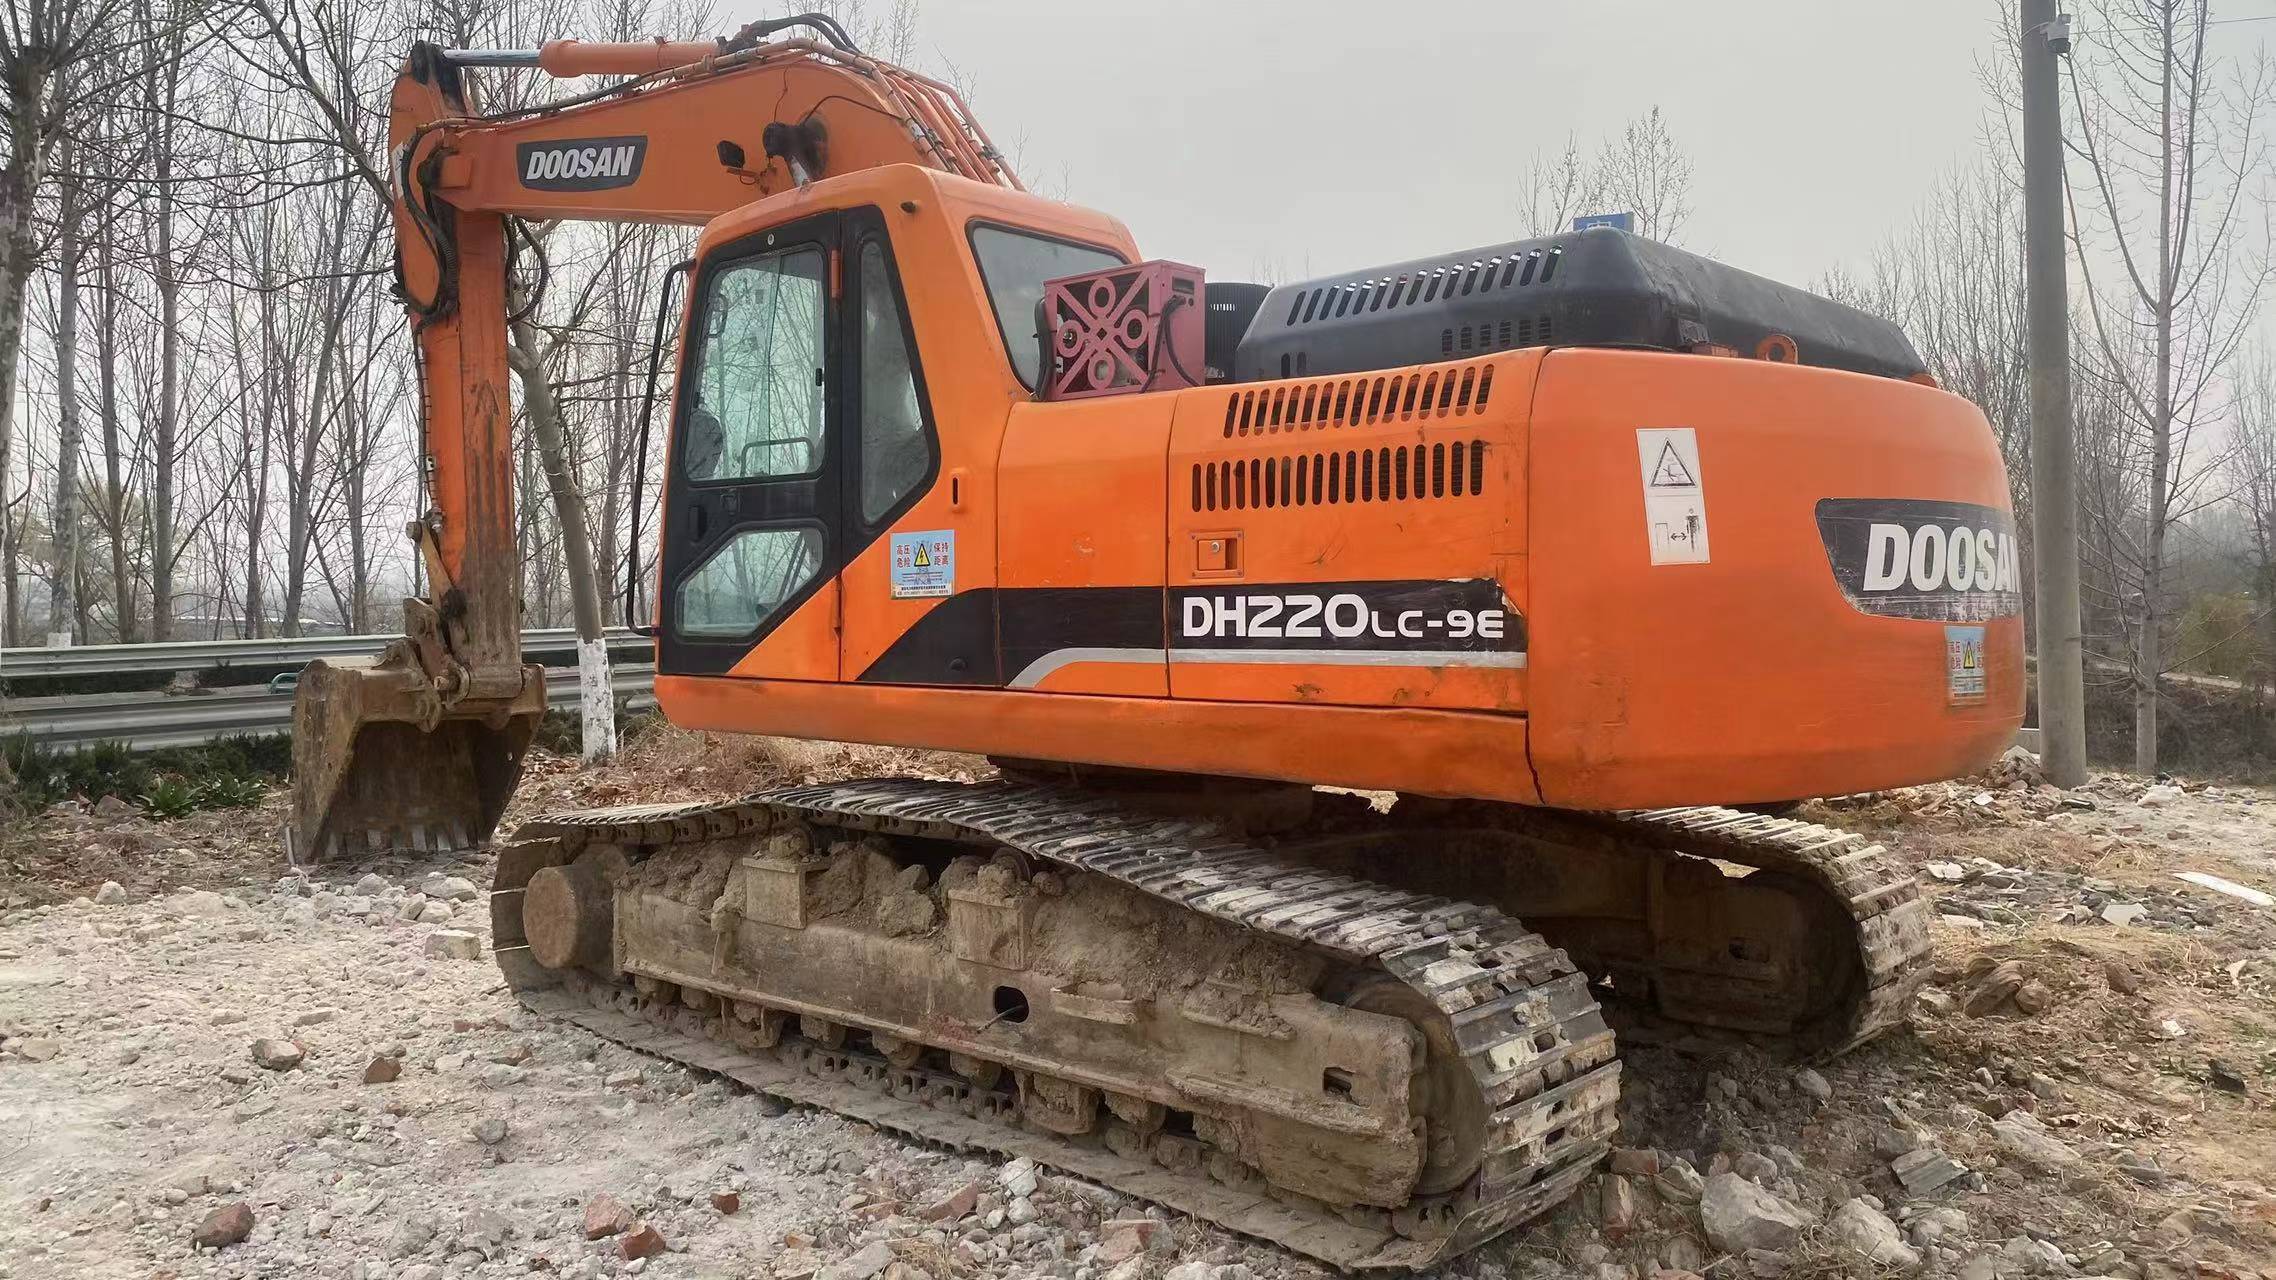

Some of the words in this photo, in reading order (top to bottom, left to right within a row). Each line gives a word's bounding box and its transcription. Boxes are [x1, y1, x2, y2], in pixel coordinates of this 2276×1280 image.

[526, 145, 636, 180] DOOSAN
[896, 544, 911, 556] 高压
[933, 542, 949, 553] 保持
[896, 557, 911, 568] 危险
[1182, 593, 1504, 639] DH220LC-9E
